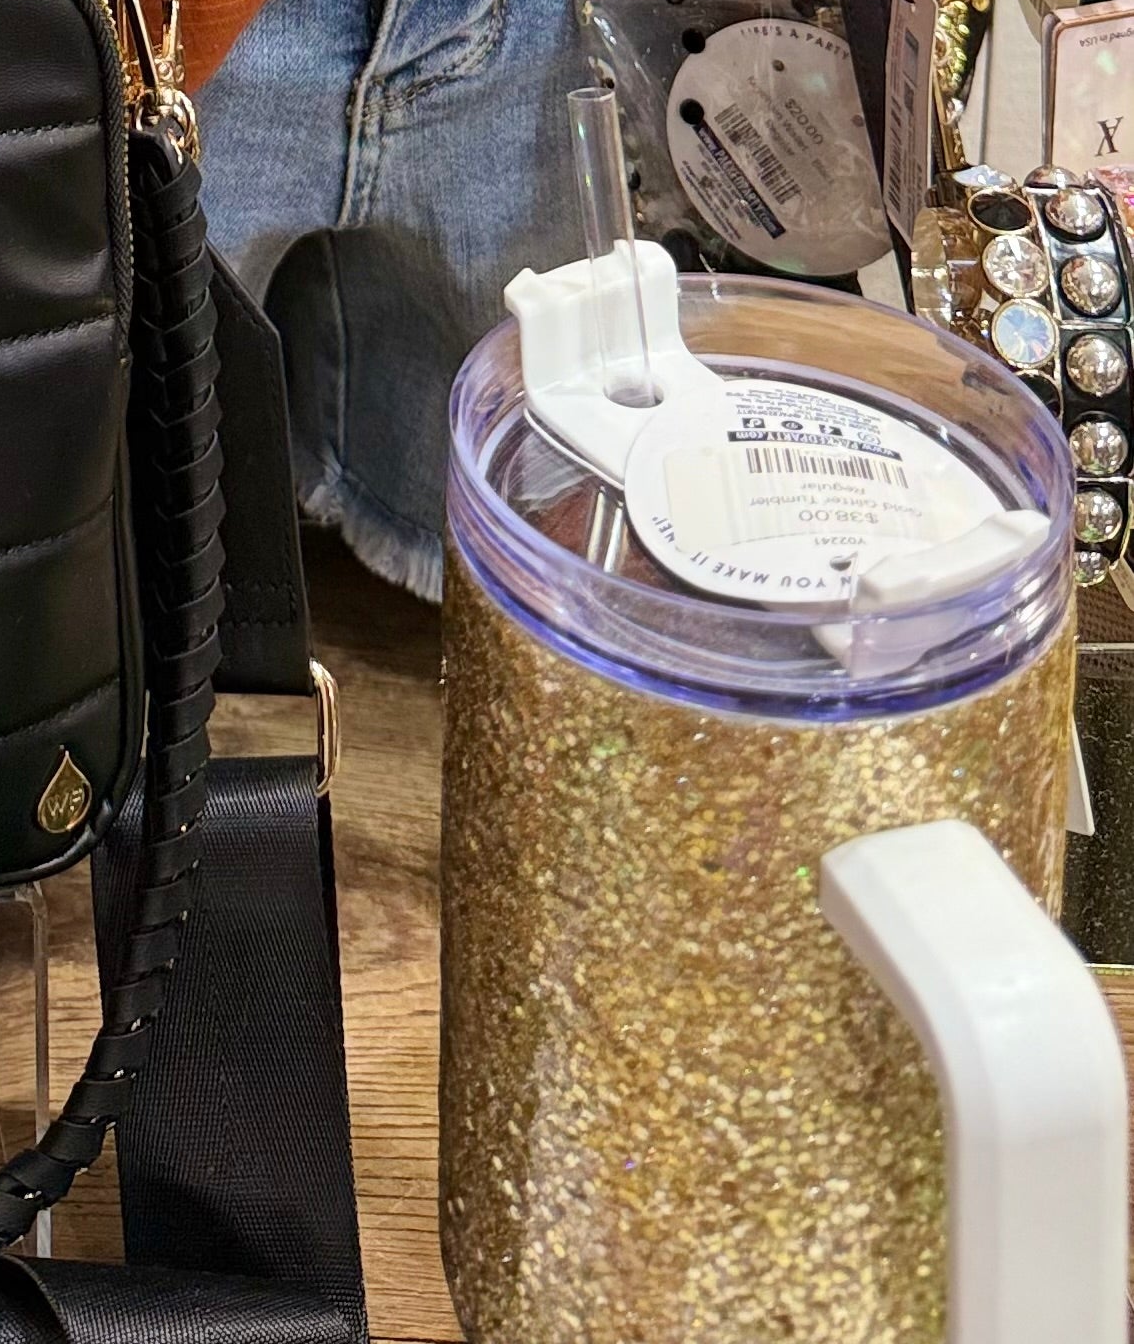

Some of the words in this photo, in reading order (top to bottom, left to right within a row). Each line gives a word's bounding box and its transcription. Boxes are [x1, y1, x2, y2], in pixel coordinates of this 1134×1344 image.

[1078, 35, 1098, 48] USA
[750, 495, 817, 506] Tumbler
[798, 509, 879, 525] $38.00
[689, 551, 709, 566] IT
[712, 562, 770, 585] MAKE
[780, 575, 826, 589] YOU
